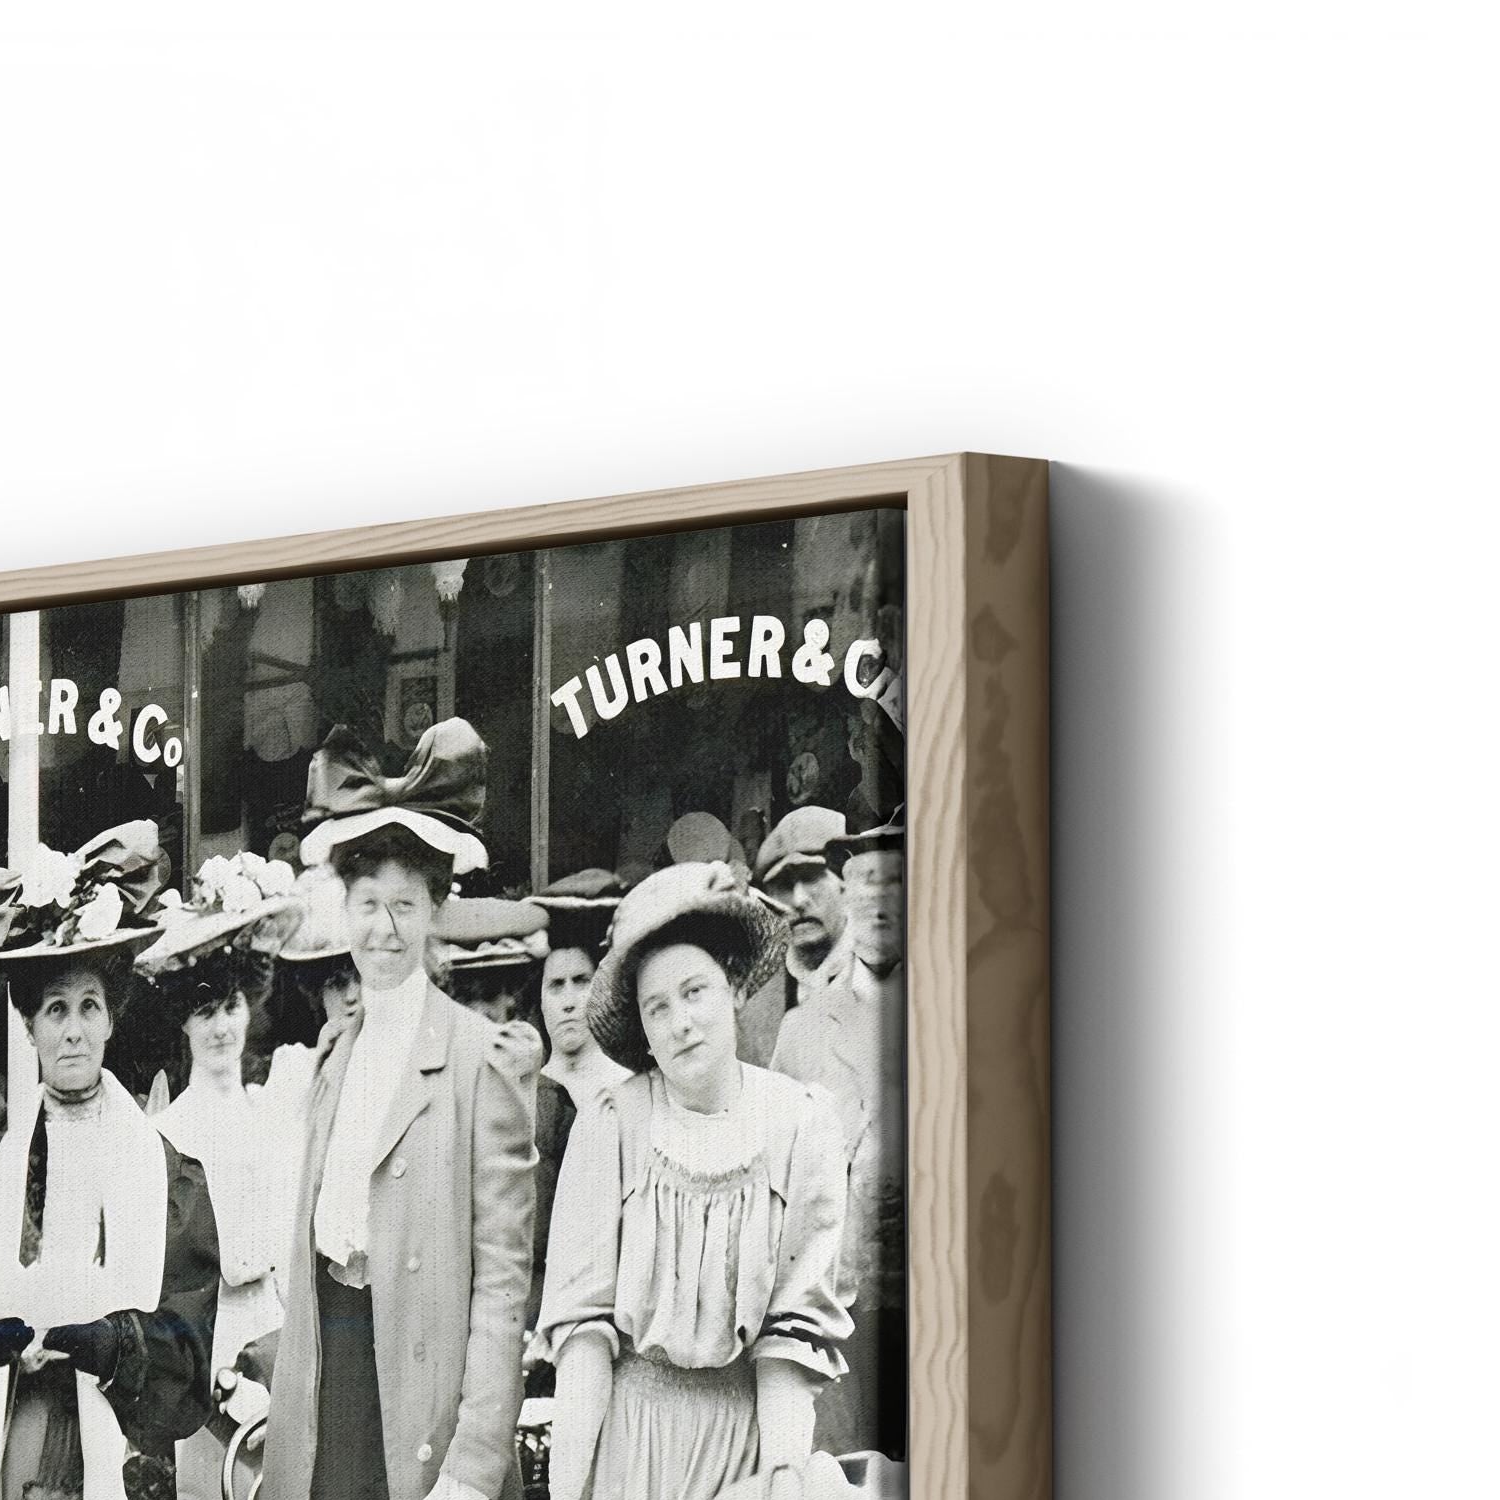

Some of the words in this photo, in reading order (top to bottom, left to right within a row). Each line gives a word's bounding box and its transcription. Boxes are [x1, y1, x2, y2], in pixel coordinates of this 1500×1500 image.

[86, 687, 124, 750] &
[550, 615, 786, 740] TURNER
[791, 618, 836, 687] &
